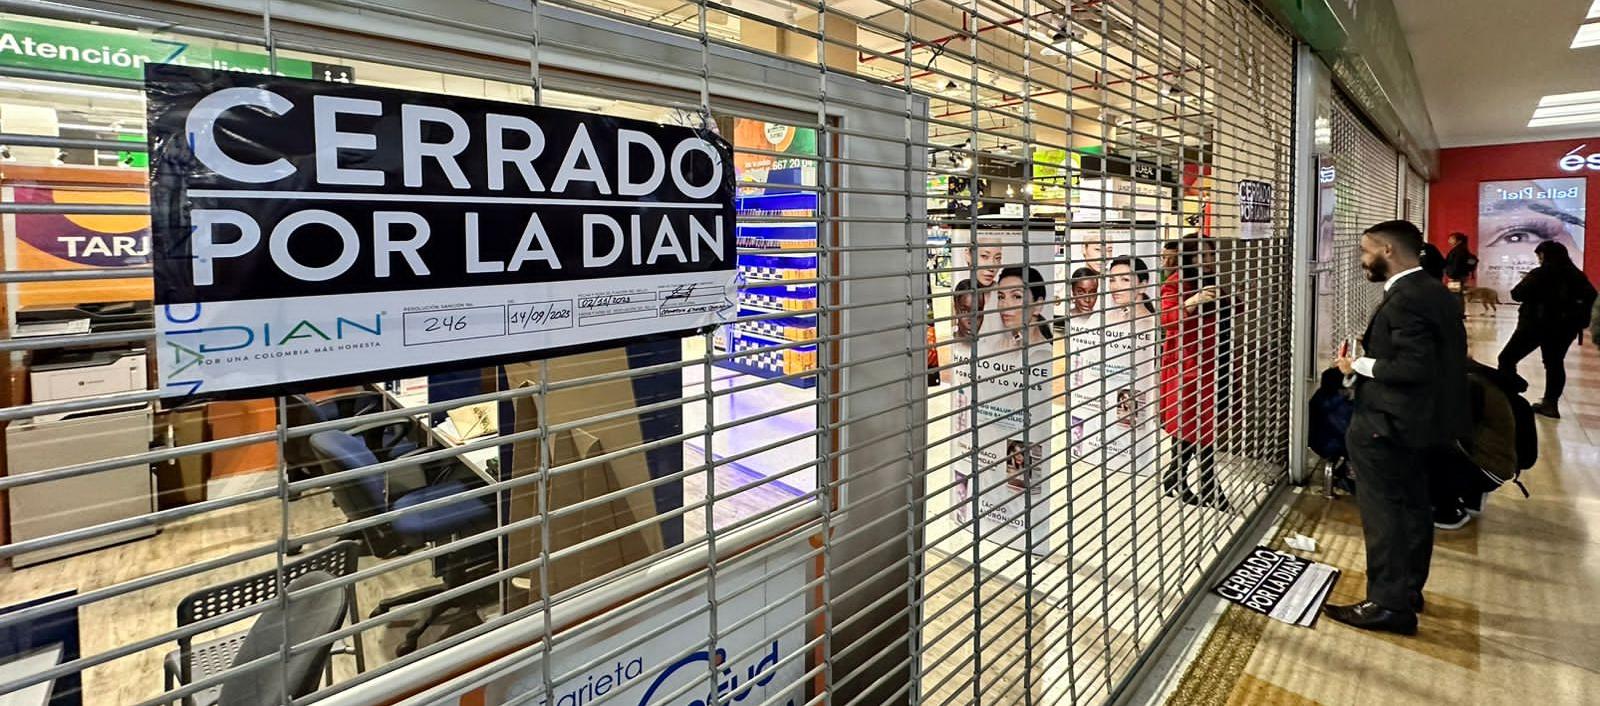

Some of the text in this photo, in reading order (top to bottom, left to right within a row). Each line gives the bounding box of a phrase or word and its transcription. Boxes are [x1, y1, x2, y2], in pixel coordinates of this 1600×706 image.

[0, 32, 149, 68] Atención
[186, 87, 723, 199] CERRADO
[190, 209, 725, 286] POR LA DIAN
[199, 313, 382, 353] DIAN
[424, 315, 467, 332] 246
[1105, 330, 1125, 338] QUE
[226, 355, 249, 363] UNA
[254, 349, 309, 360] COLOMBIA
[338, 341, 382, 350] HONESTA
[977, 361, 989, 369] LO
[993, 362, 1016, 372] QUE
[998, 379, 1009, 387] LO
[1217, 550, 1280, 600] CERRADO
[1246, 562, 1306, 613] POR LA DIAN
[539, 656, 643, 706] arjeta
